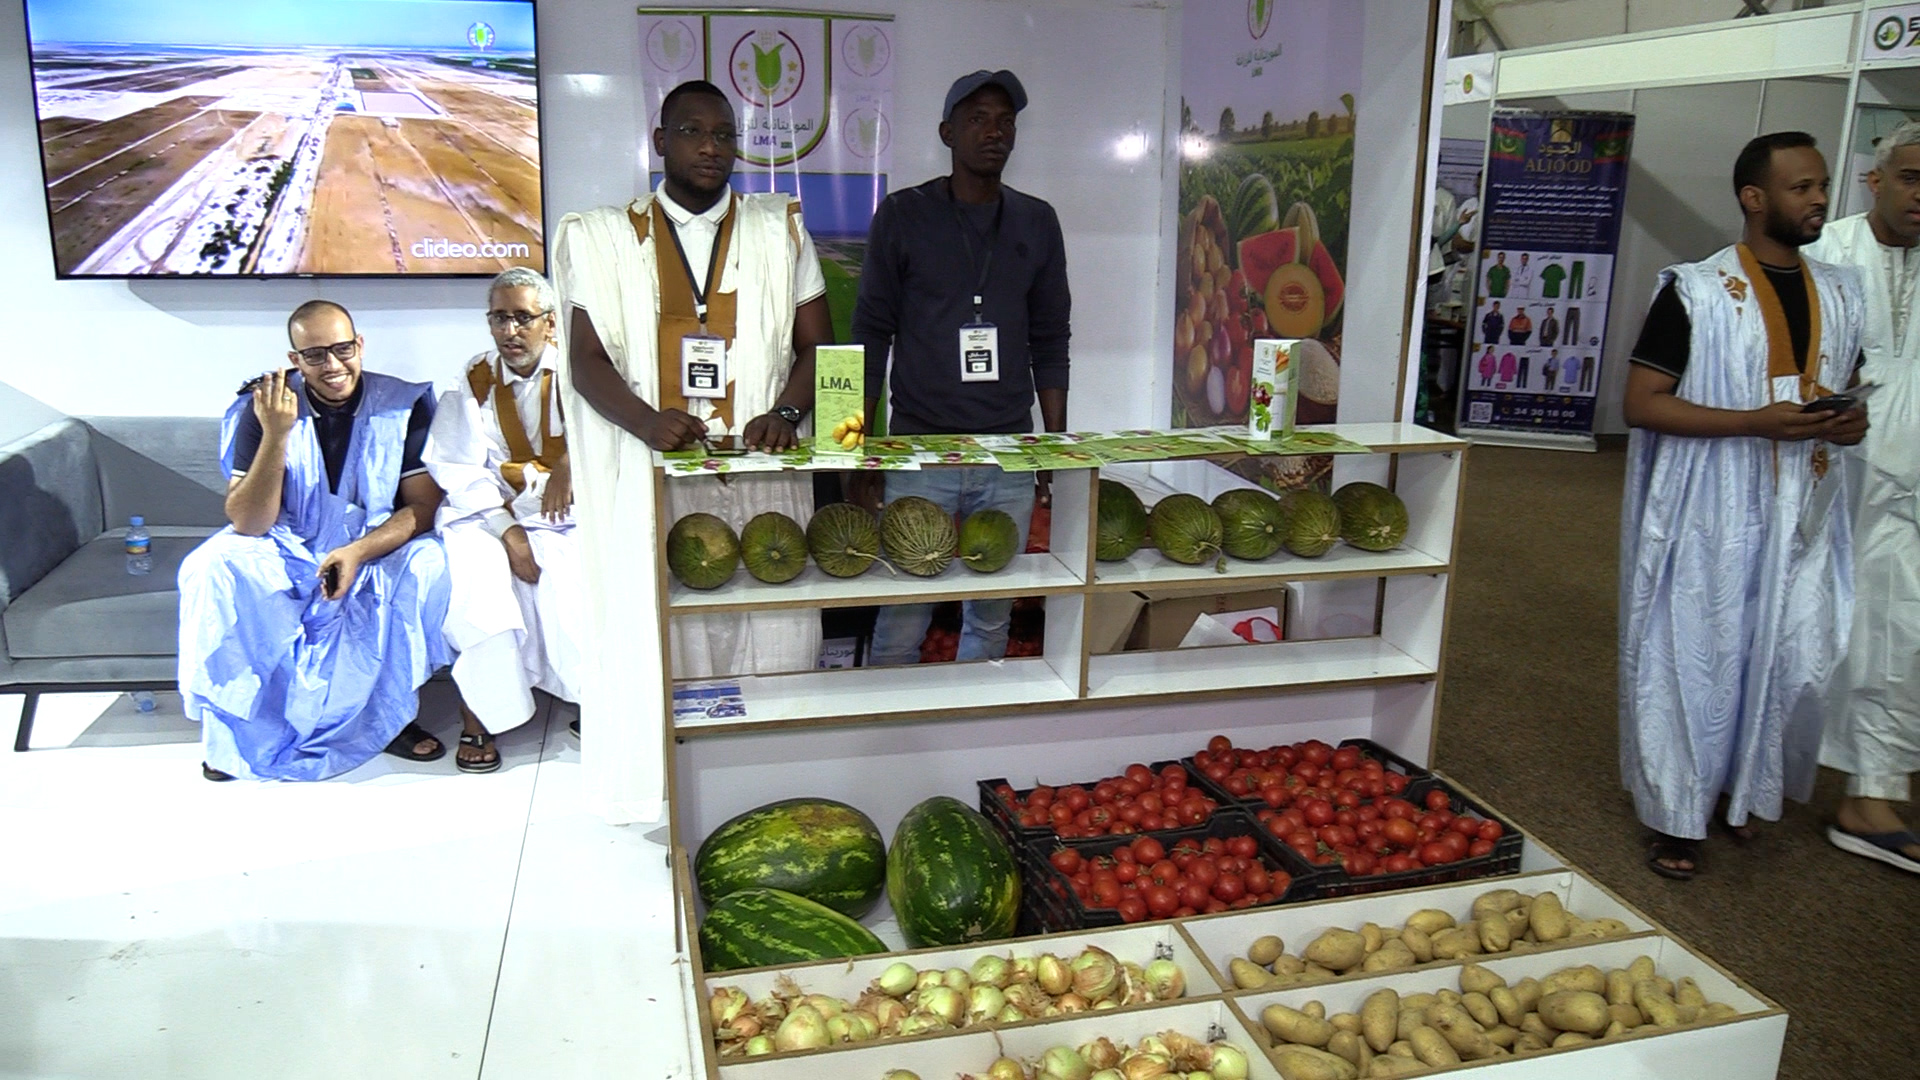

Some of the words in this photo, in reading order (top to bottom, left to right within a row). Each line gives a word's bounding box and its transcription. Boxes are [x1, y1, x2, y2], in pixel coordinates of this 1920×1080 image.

[753, 135, 777, 146] LMA
[1524, 158, 1592, 174] ALJOOD
[411, 238, 530, 259] clideo.com
[820, 376, 852, 390] LMA
